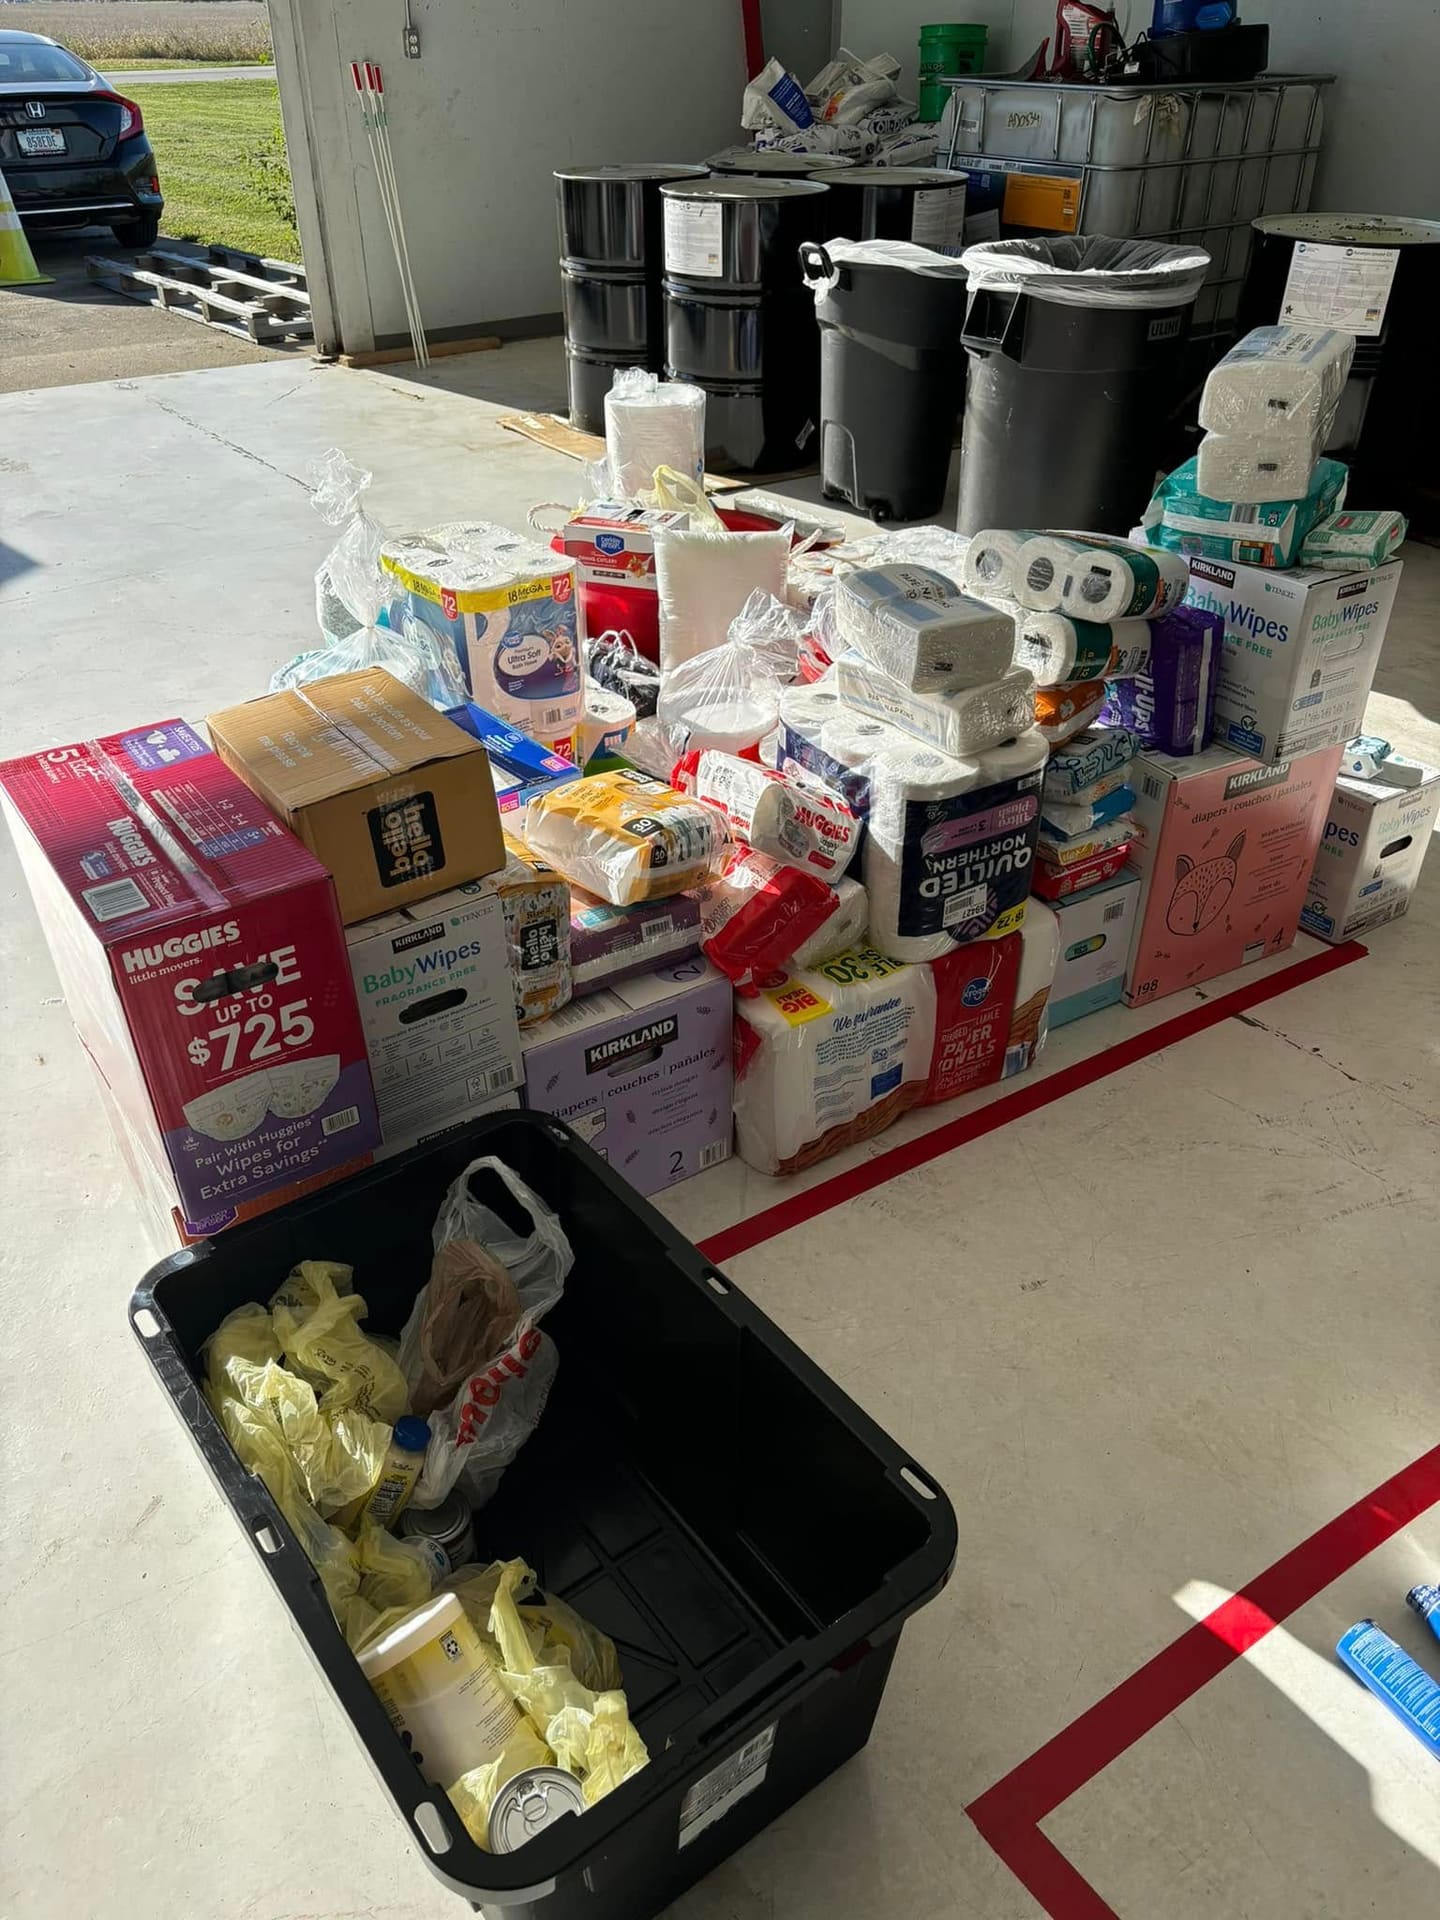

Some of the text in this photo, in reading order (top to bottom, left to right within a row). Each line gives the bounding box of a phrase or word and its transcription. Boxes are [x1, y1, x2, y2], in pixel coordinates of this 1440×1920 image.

[1192, 560, 1234, 581] KIRKLAND
[442, 594, 457, 612] 72
[508, 578, 571, 603] 18 MEGA 72
[1354, 621, 1371, 632] FREE
[508, 649, 541, 665] Ultra Soft
[1245, 640, 1273, 658] FREE
[512, 662, 524, 670] Bath
[884, 704, 914, 720] NAPKINS
[46, 748, 81, 762] 5
[555, 742, 572, 756] 72
[1229, 762, 1289, 790] KIRKLAND
[998, 801, 1031, 817] Plush
[998, 811, 1034, 828] Ultra
[1191, 806, 1228, 825] diapers
[1233, 791, 1272, 811] couches
[404, 803, 432, 866] hello
[632, 819, 650, 832] 30
[793, 806, 851, 843] HUGGIES
[978, 820, 987, 831] 3
[106, 816, 157, 867] HUGGIES
[382, 811, 411, 876] bello
[933, 833, 1027, 873] NORTHERN
[919, 847, 1032, 898] QUILTED
[121, 920, 240, 974] HUGGIES
[394, 924, 444, 949] KIRKLAND
[526, 929, 540, 966] hello
[540, 925, 552, 962] bello
[1272, 927, 1284, 946] 4
[129, 957, 203, 985] little movers.
[673, 963, 701, 981] 2
[823, 957, 869, 984] 30
[376, 965, 478, 1008] FRAGRANCE FREE
[1137, 979, 1159, 997] 198
[216, 993, 273, 1024] UP TO
[782, 993, 819, 1013] BIG
[833, 1017, 853, 1033] We
[590, 1020, 674, 1062] KIRKLAND
[607, 1069, 660, 1098] couches
[669, 1046, 717, 1075] pañales
[195, 1150, 222, 1169] Pair
[224, 1136, 257, 1157] With
[216, 1135, 301, 1177] Wipes for
[669, 1150, 685, 1175] 2
[200, 1173, 248, 1200] Extra
